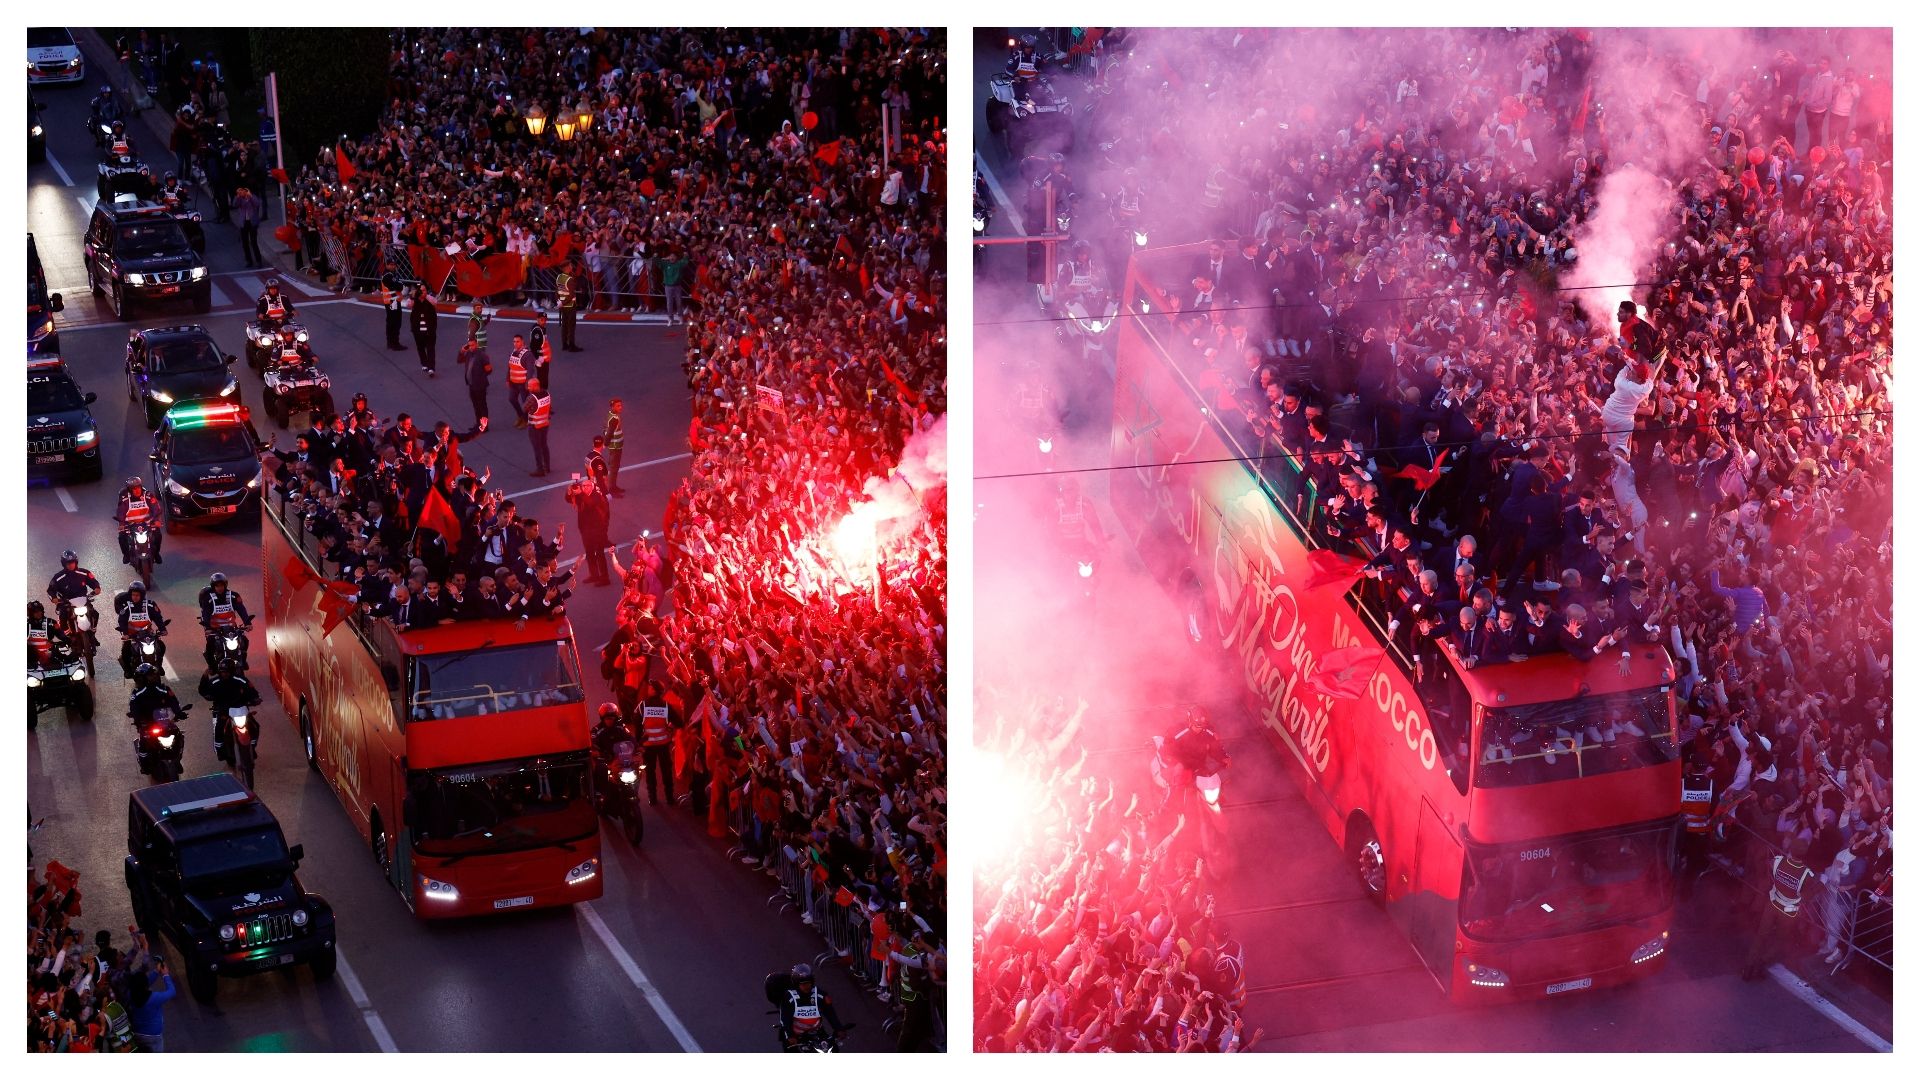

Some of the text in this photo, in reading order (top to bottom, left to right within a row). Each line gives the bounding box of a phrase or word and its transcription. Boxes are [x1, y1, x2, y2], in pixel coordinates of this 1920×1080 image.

[1331, 612, 1437, 770] MOCCO
[449, 772, 476, 784] 90604
[1520, 847, 1551, 861] 90604
[232, 896, 283, 911] الشرطة
